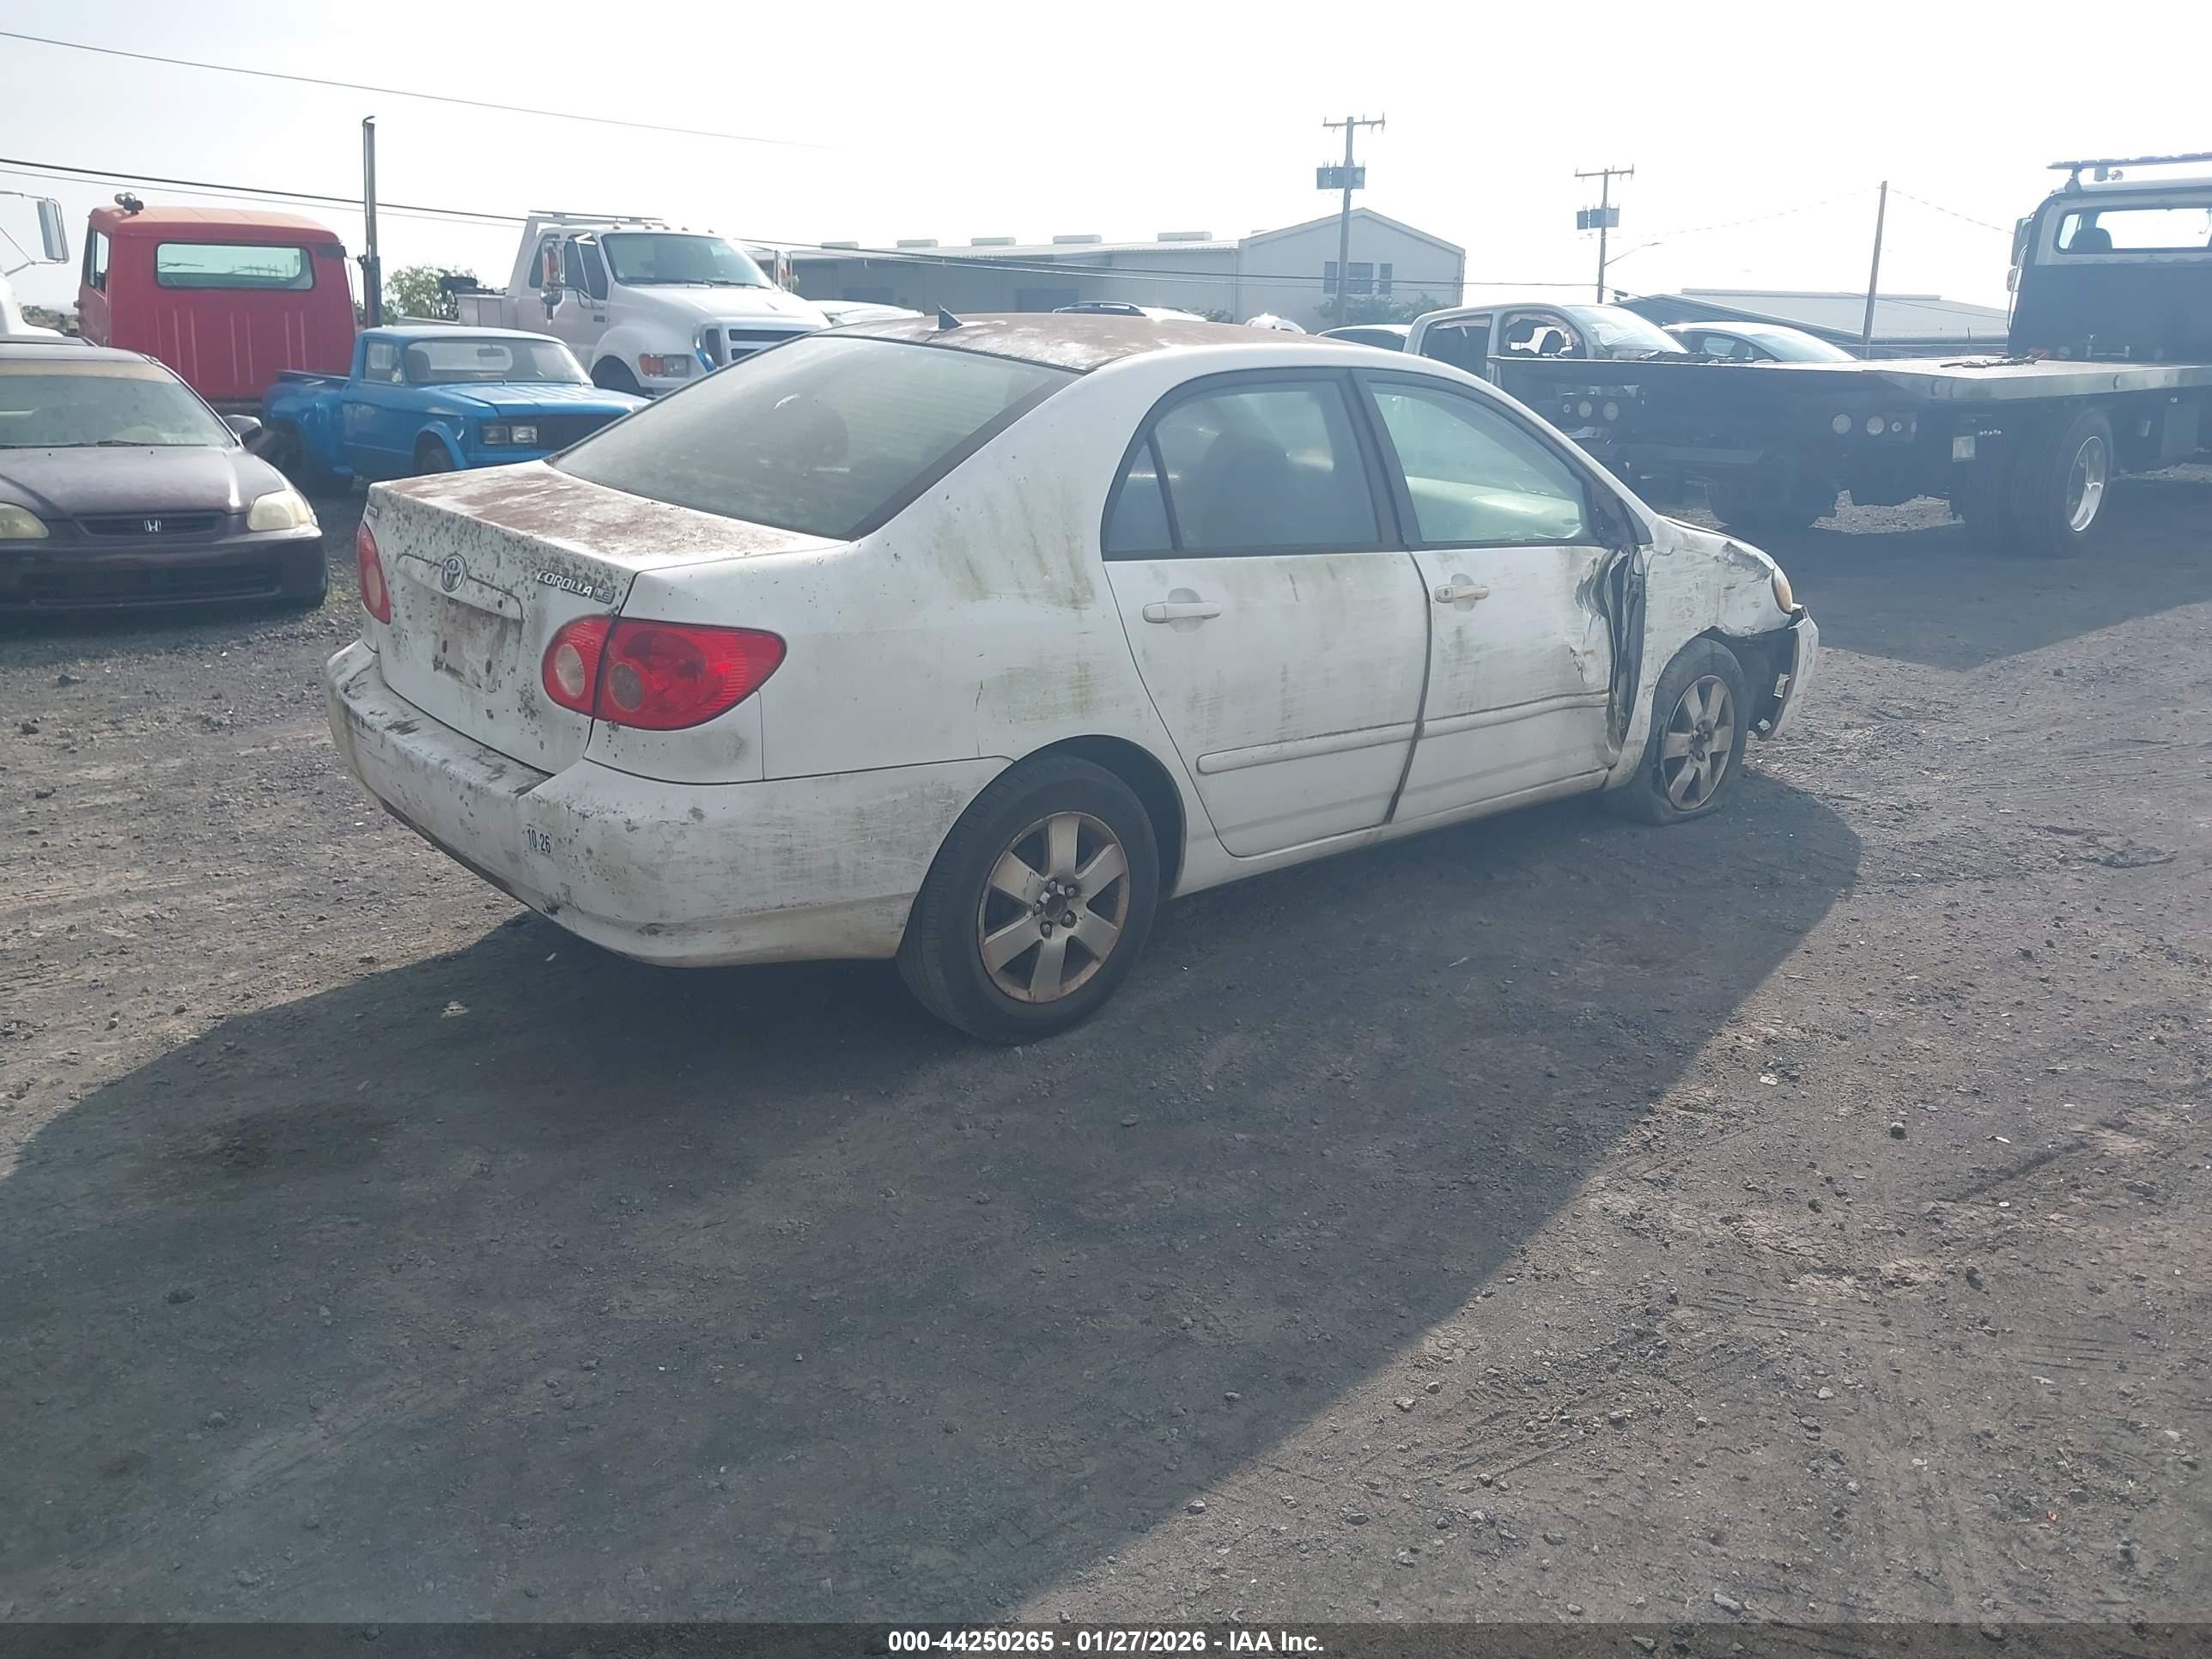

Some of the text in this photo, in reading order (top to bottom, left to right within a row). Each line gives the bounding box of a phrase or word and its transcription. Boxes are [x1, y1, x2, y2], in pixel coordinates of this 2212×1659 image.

[537, 570, 615, 605] COROLLA LE
[527, 828, 551, 854] 10 26
